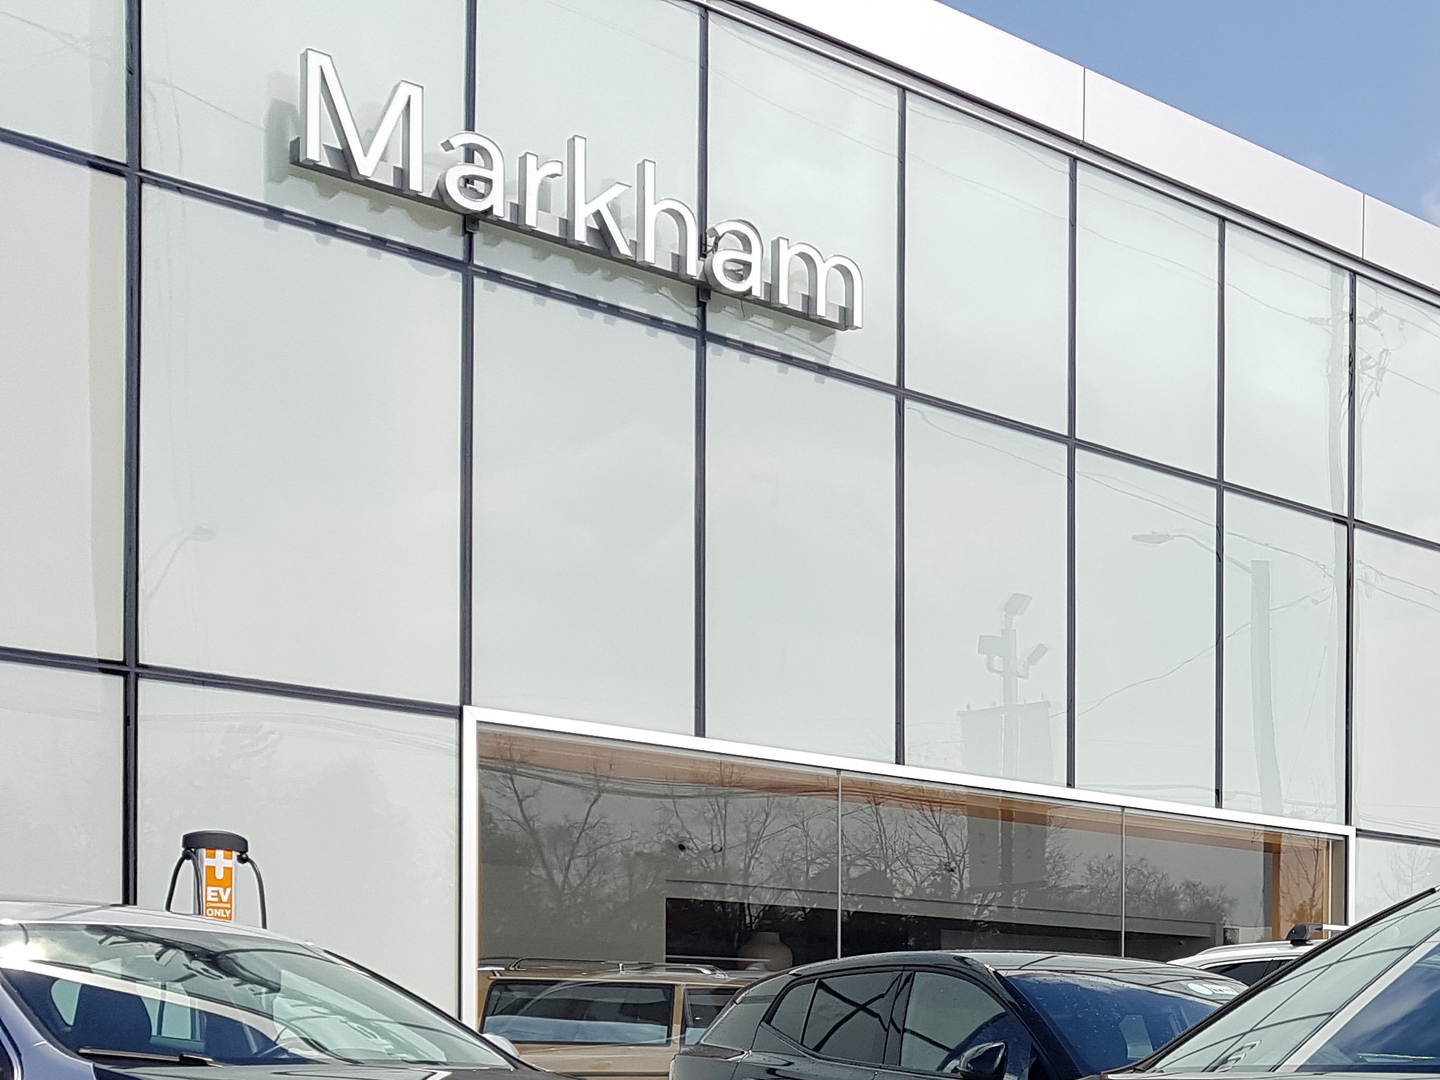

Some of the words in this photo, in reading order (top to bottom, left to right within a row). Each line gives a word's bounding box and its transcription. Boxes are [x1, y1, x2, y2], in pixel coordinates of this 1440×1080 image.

[300, 47, 865, 330] Markham
[206, 886, 232, 902] EV
[206, 908, 231, 918] ONLY
